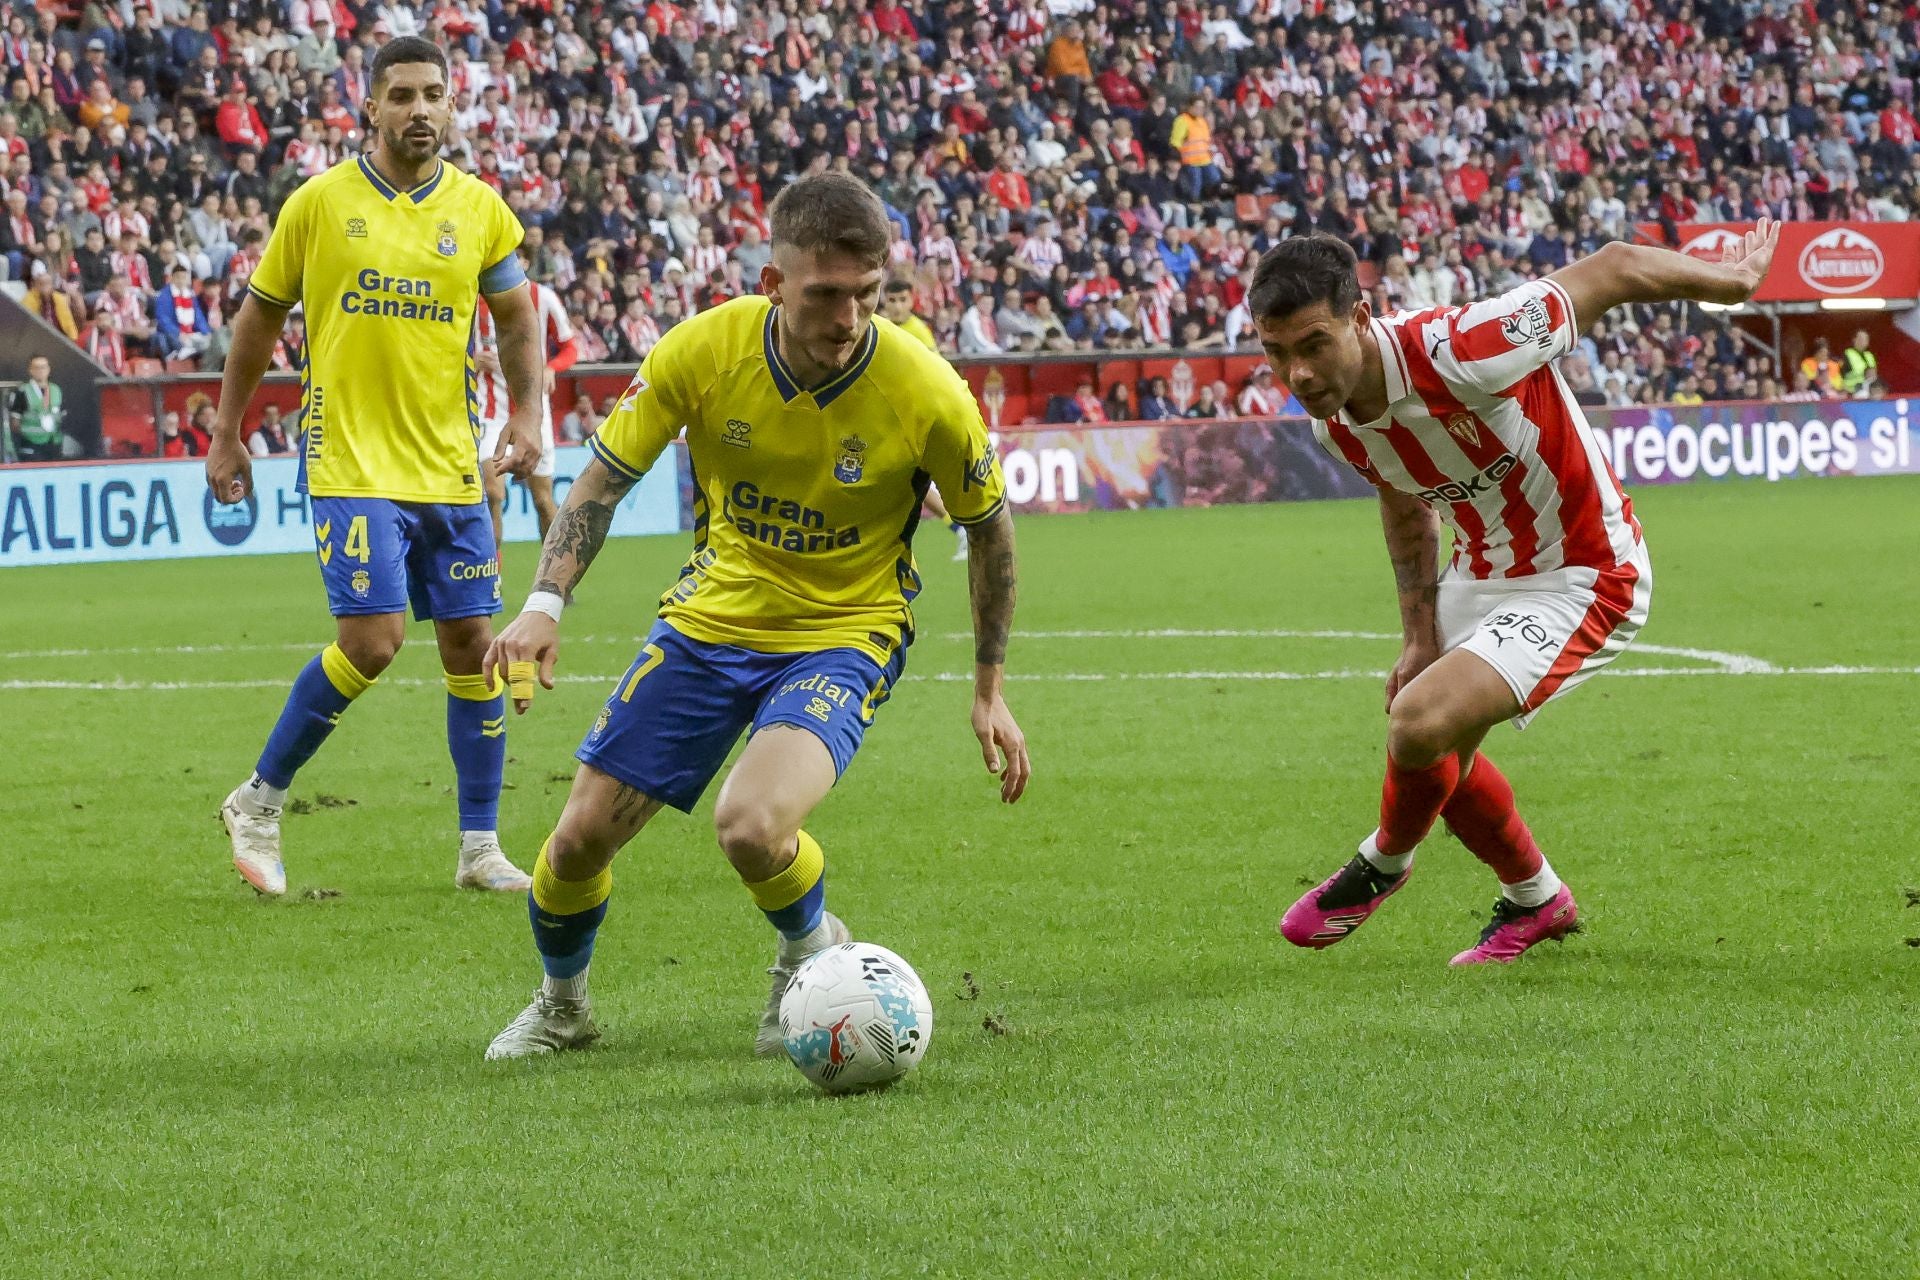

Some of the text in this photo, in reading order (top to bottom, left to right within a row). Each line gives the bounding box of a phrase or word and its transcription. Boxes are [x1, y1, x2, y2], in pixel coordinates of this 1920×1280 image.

[358, 268, 431, 297] Gran
[341, 291, 454, 323] Canaria
[1522, 299, 1552, 350] INTEGRA
[1870, 398, 1910, 469] si
[989, 432, 1079, 503] on
[731, 481, 825, 529] Gran
[344, 516, 370, 563] 4
[771, 673, 852, 708] ordial
